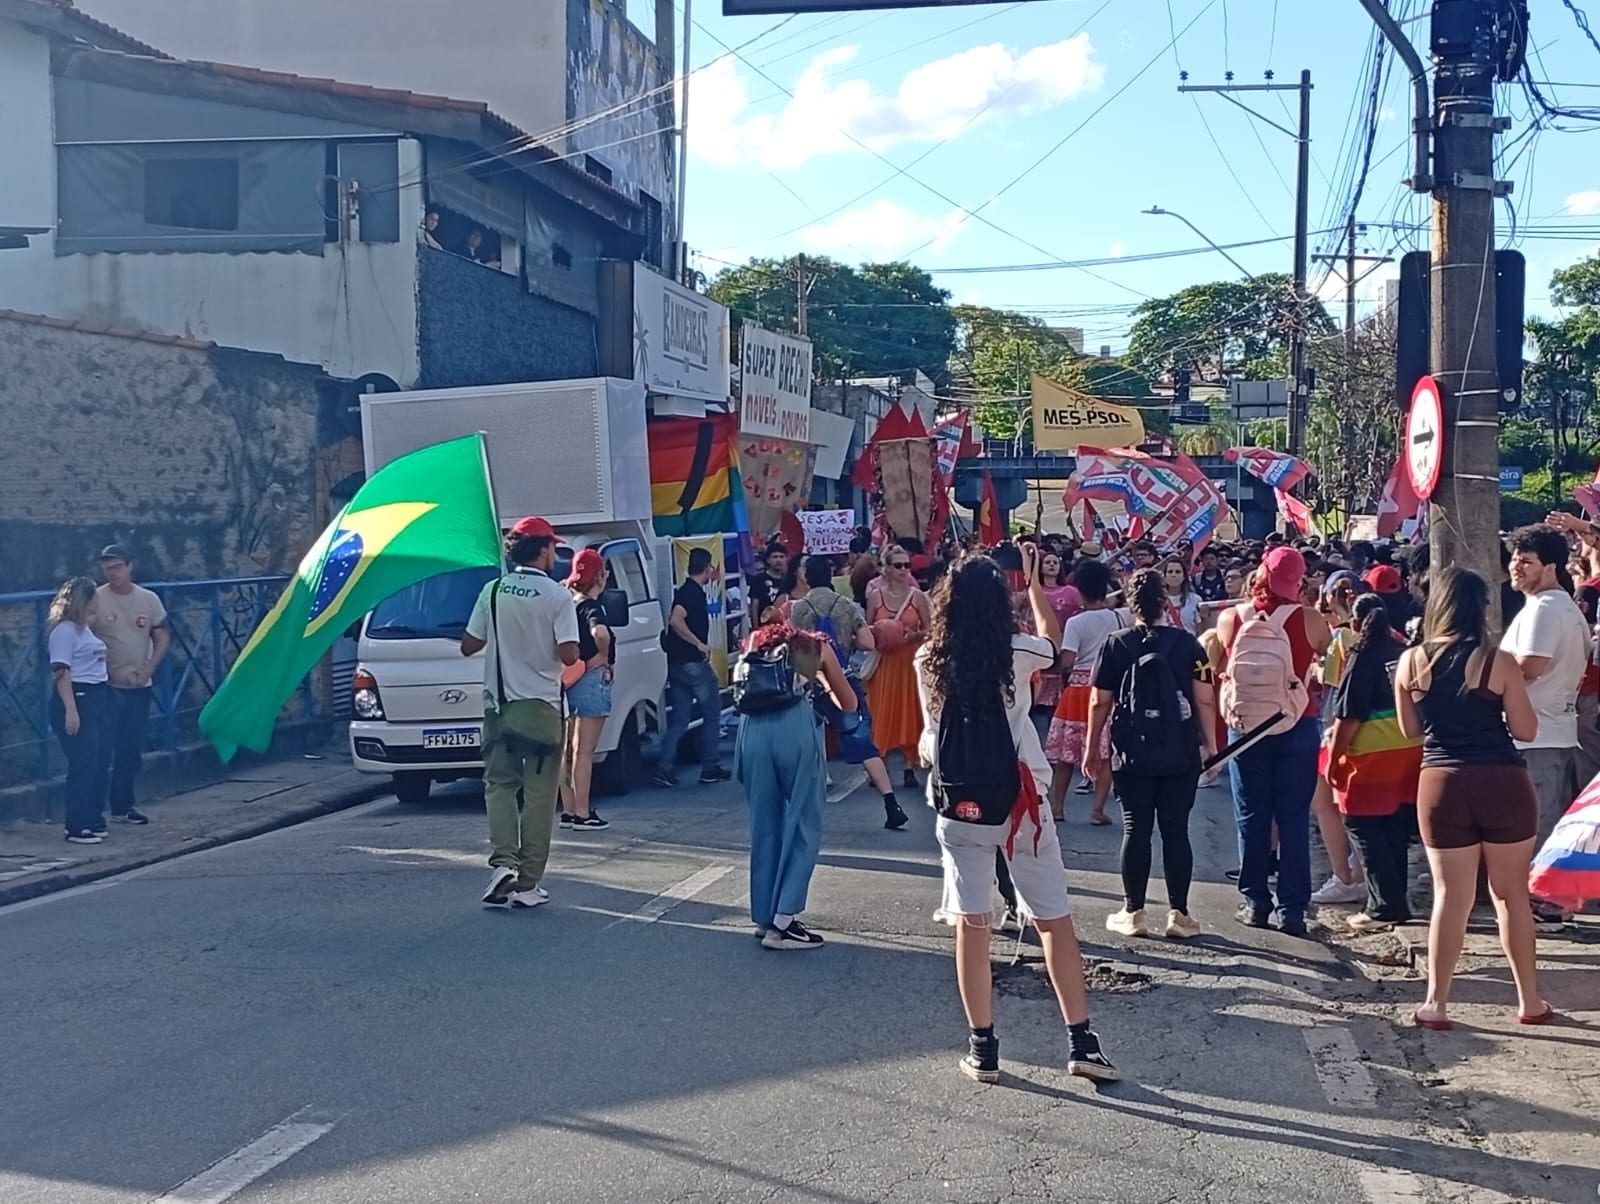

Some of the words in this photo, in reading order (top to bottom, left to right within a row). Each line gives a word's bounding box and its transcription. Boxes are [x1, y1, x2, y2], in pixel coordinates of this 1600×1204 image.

[664, 293, 708, 365] BANDEIRAS
[745, 342, 776, 380] SUPER
[1044, 409, 1131, 425] MES-PSOL
[1499, 469, 1519, 479] eira
[496, 582, 531, 598] ictor
